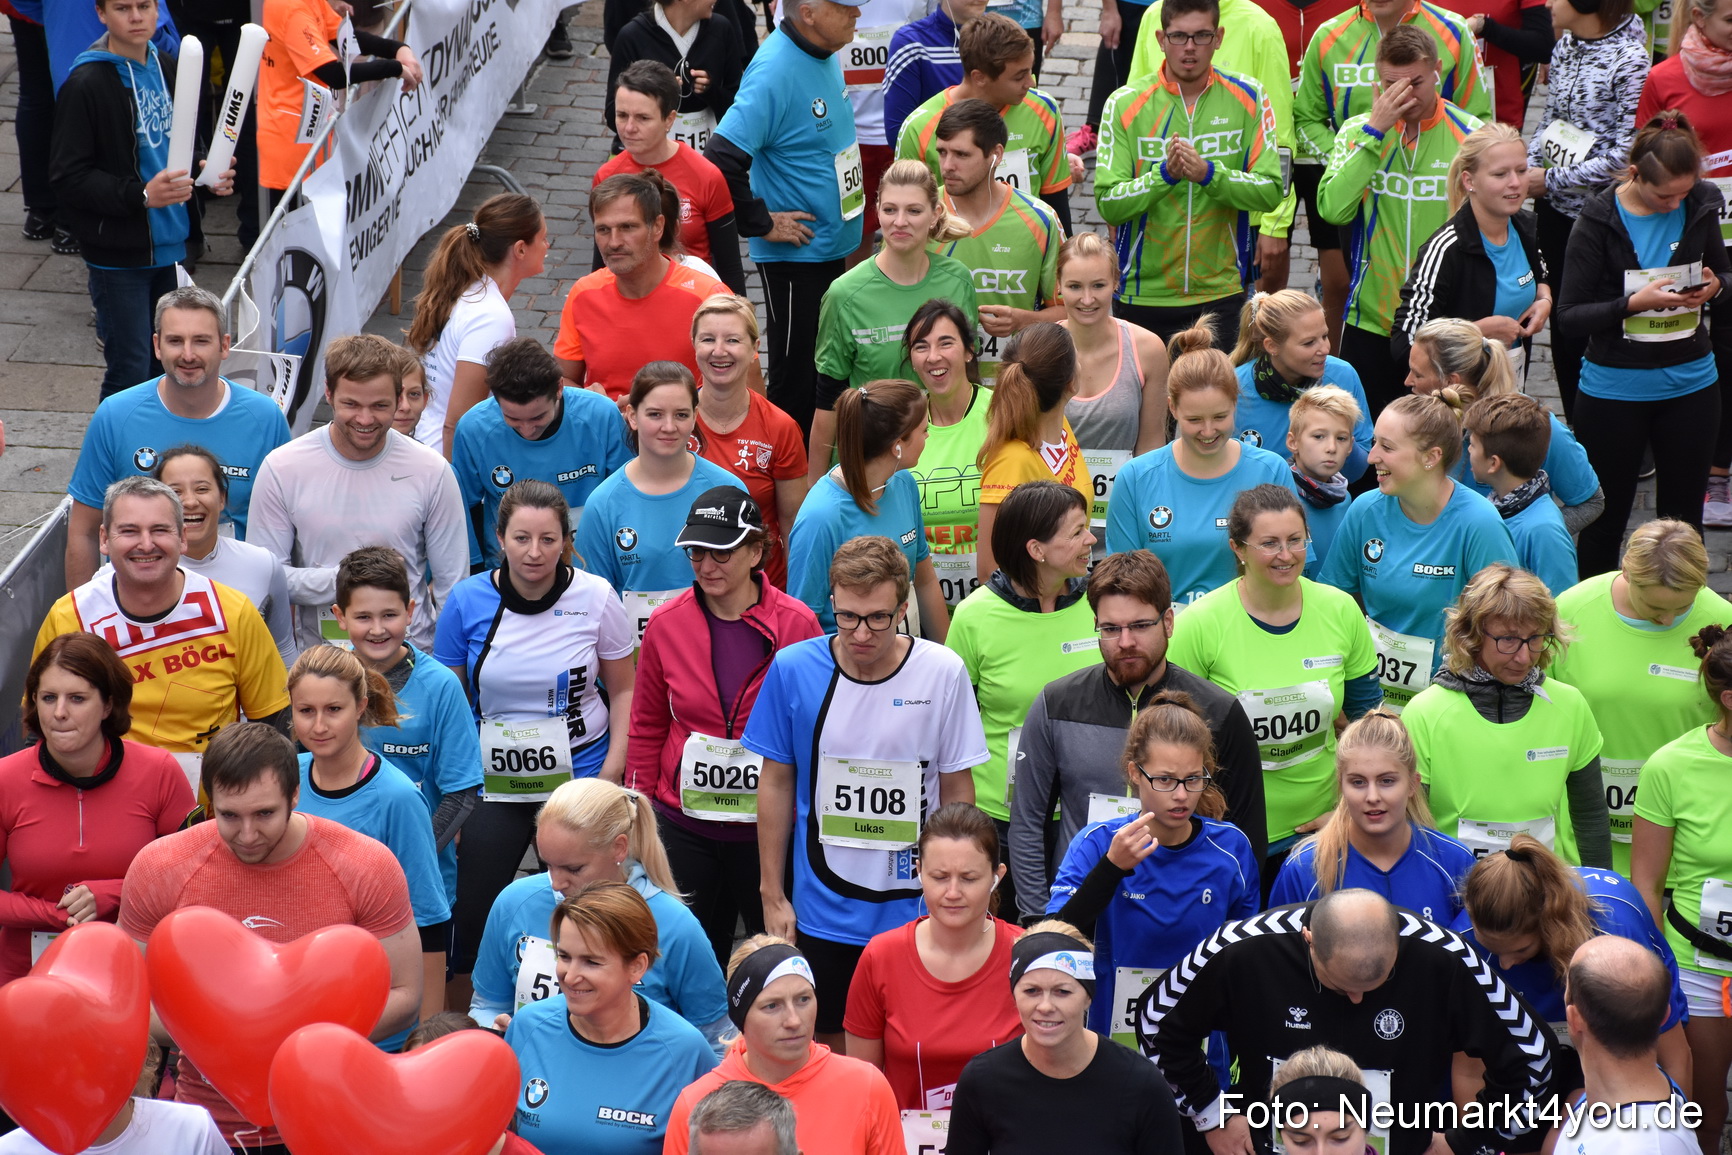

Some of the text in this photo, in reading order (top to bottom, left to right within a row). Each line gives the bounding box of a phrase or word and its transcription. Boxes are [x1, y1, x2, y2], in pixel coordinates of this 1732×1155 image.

[1137, 129, 1243, 162] BCK
[349, 205, 390, 272] ENIGER
[1649, 318, 1680, 329] Barbara
[1083, 456, 1113, 465] BOCK
[557, 464, 598, 483] BOCK
[619, 553, 641, 562] PARTL
[941, 561, 971, 569] BOCK
[1412, 563, 1456, 577] BOCK
[1383, 634, 1407, 651] BOCK
[162, 643, 236, 675] BÖGL
[547, 688, 555, 709] WASTE
[1273, 692, 1308, 705] BOCK
[1383, 688, 1412, 702] Carina
[1253, 709, 1321, 741] 5040
[383, 743, 430, 755] BOCK
[714, 745, 746, 756] BOCK
[1270, 743, 1303, 757] Claudia
[491, 745, 557, 773] 5066
[693, 761, 758, 790] 5026
[858, 766, 894, 777] BOCK
[509, 779, 544, 790] Simone
[714, 796, 740, 807] Vroni
[834, 784, 906, 816] 5108
[854, 821, 885, 835] Lukas
[1202, 888, 1212, 905] 6
[1285, 1020, 1312, 1030] hummel
[597, 1106, 657, 1127] BOCK
